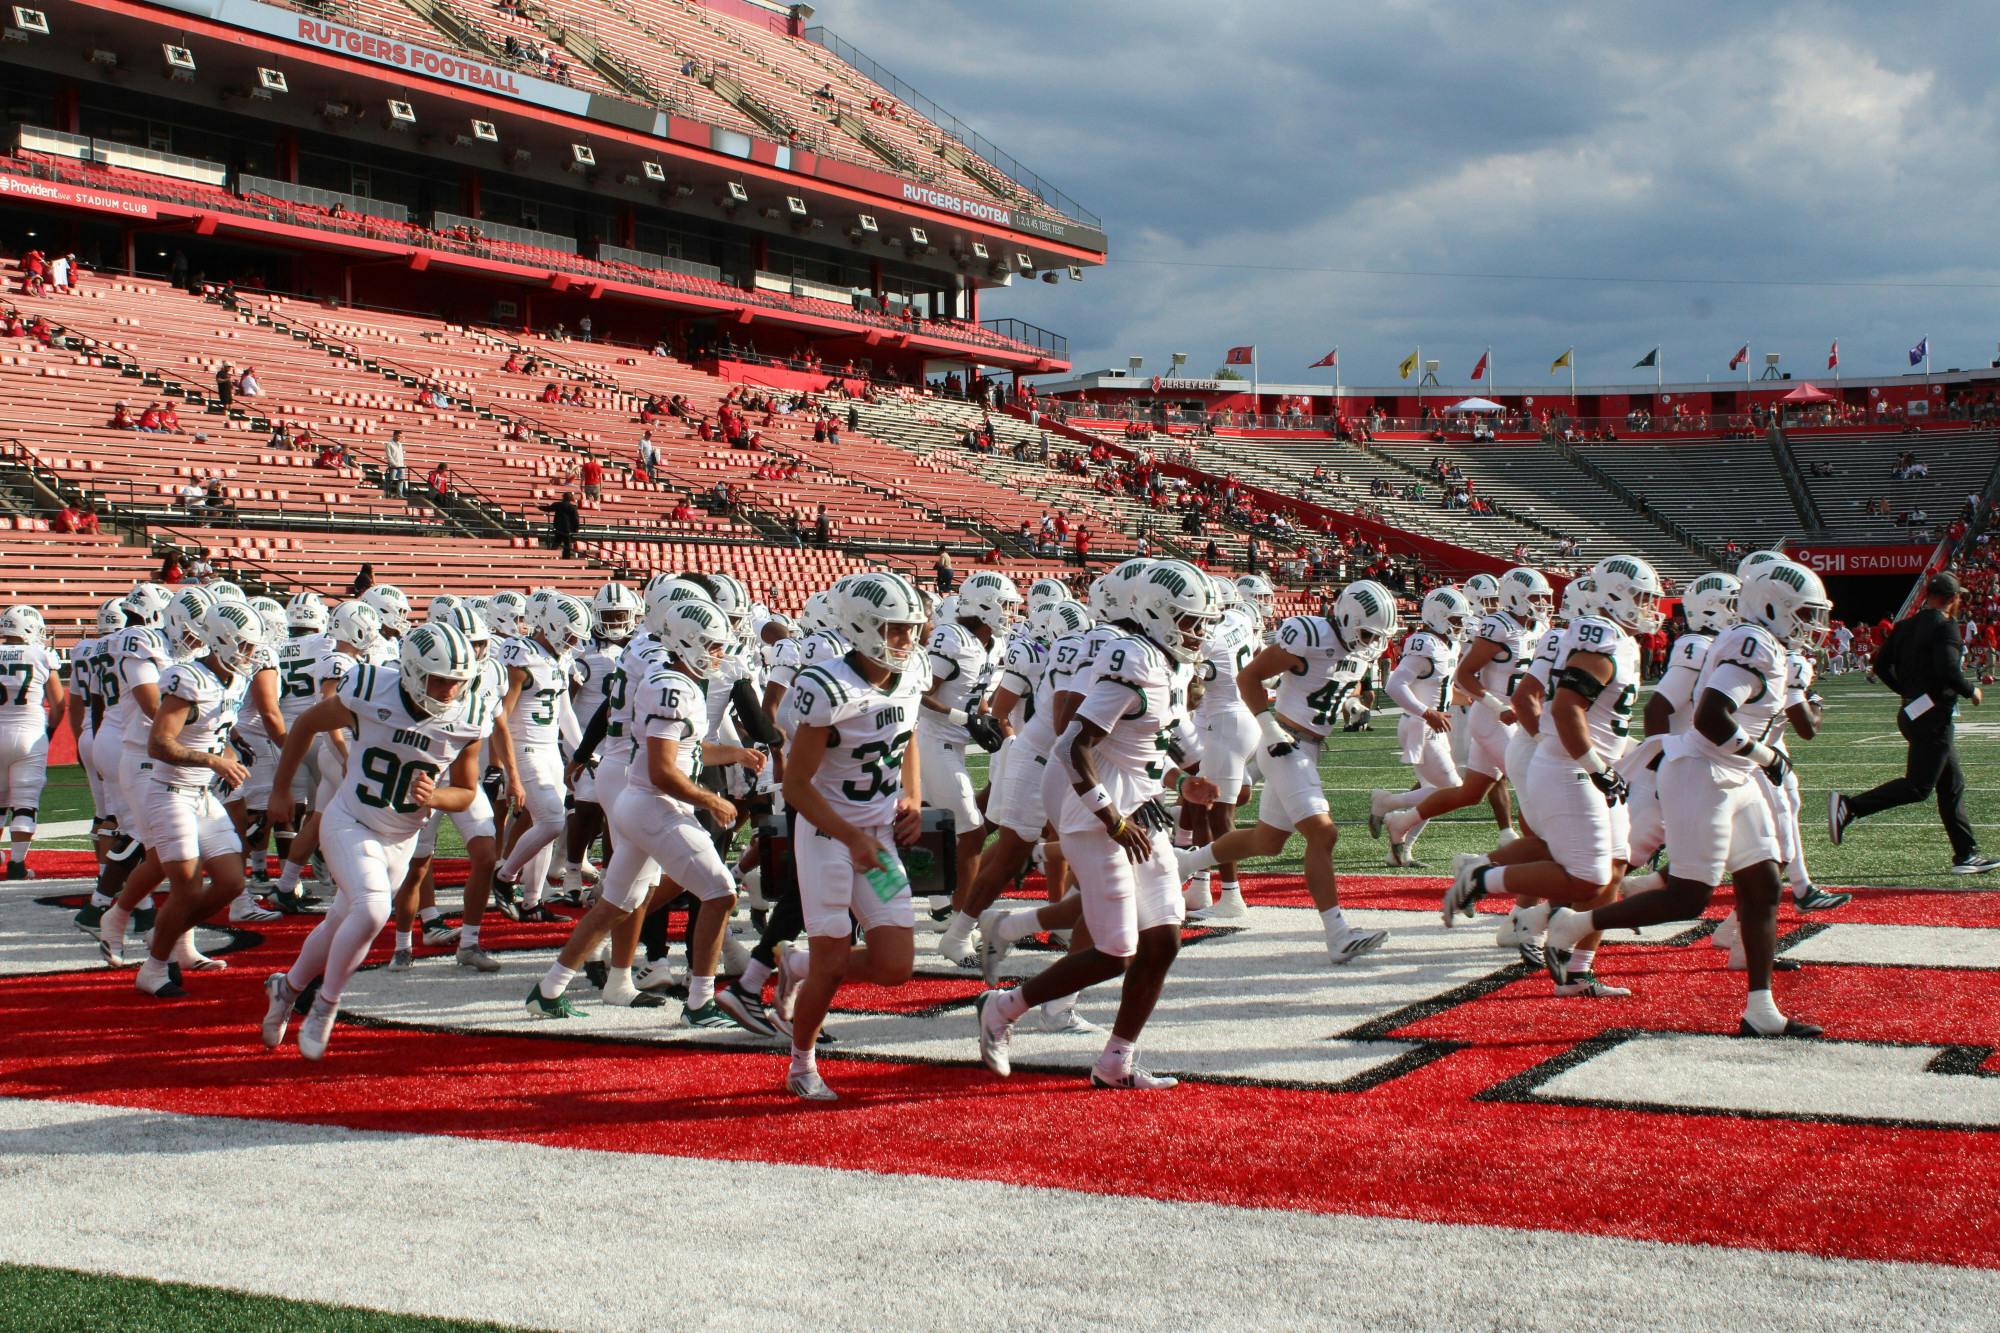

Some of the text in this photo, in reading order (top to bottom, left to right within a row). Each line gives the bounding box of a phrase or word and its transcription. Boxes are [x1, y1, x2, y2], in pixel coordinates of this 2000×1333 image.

[298, 19, 519, 94] RUTGERS FOOTBALL
[10, 179, 58, 199] Provident
[76, 194, 119, 209] STADIUM
[122, 202, 148, 214] CLUB
[903, 184, 1010, 224] RUTGERS FOOTBA
[1162, 380, 1198, 390] JERSEY
[1606, 560, 1638, 580] OHIO
[1812, 554, 1922, 571] SHI STADIUM
[976, 576, 1002, 590] OHIO
[1150, 568, 1187, 598] OHIO
[1695, 578, 1722, 595] OHIO
[1769, 566, 1806, 592] OHIO
[380, 588, 400, 600] OHIO
[670, 588, 699, 601] OHI
[852, 581, 888, 608] OHIO
[1032, 584, 1051, 596] OHIO
[180, 594, 204, 620] OHIO
[475, 600, 489, 608] OH
[497, 594, 518, 606] OHIO
[1354, 590, 1379, 618] OHIO
[1434, 592, 1456, 610] OHIO
[105, 615, 116, 624] 65
[219, 606, 248, 630] OHIO
[304, 610, 314, 620] 55
[558, 602, 580, 623] OHIO
[681, 606, 713, 630] OHIO
[1060, 607, 1080, 630] OHIO
[334, 620, 340, 629] 6
[1480, 623, 1496, 638] 27
[934, 632, 945, 648] 2
[1282, 625, 1298, 645] 40
[1578, 624, 1604, 644] 99
[122, 636, 138, 652] 16
[503, 646, 520, 660] 37
[776, 644, 784, 657] 7
[805, 642, 816, 659] 3
[1410, 638, 1424, 652] 13
[1684, 642, 1694, 660] 4
[1740, 636, 1757, 658] 0
[1057, 646, 1078, 664] 57
[1110, 650, 1126, 672] 9
[333, 662, 342, 675] 6
[1336, 660, 1358, 674] OHIO
[1792, 662, 1803, 680] 7
[168, 674, 181, 692] 3
[660, 688, 680, 708] 16
[794, 686, 815, 716] 39
[876, 706, 904, 730] OHIO
[392, 728, 431, 752] OHIO
[356, 746, 440, 814] 90
